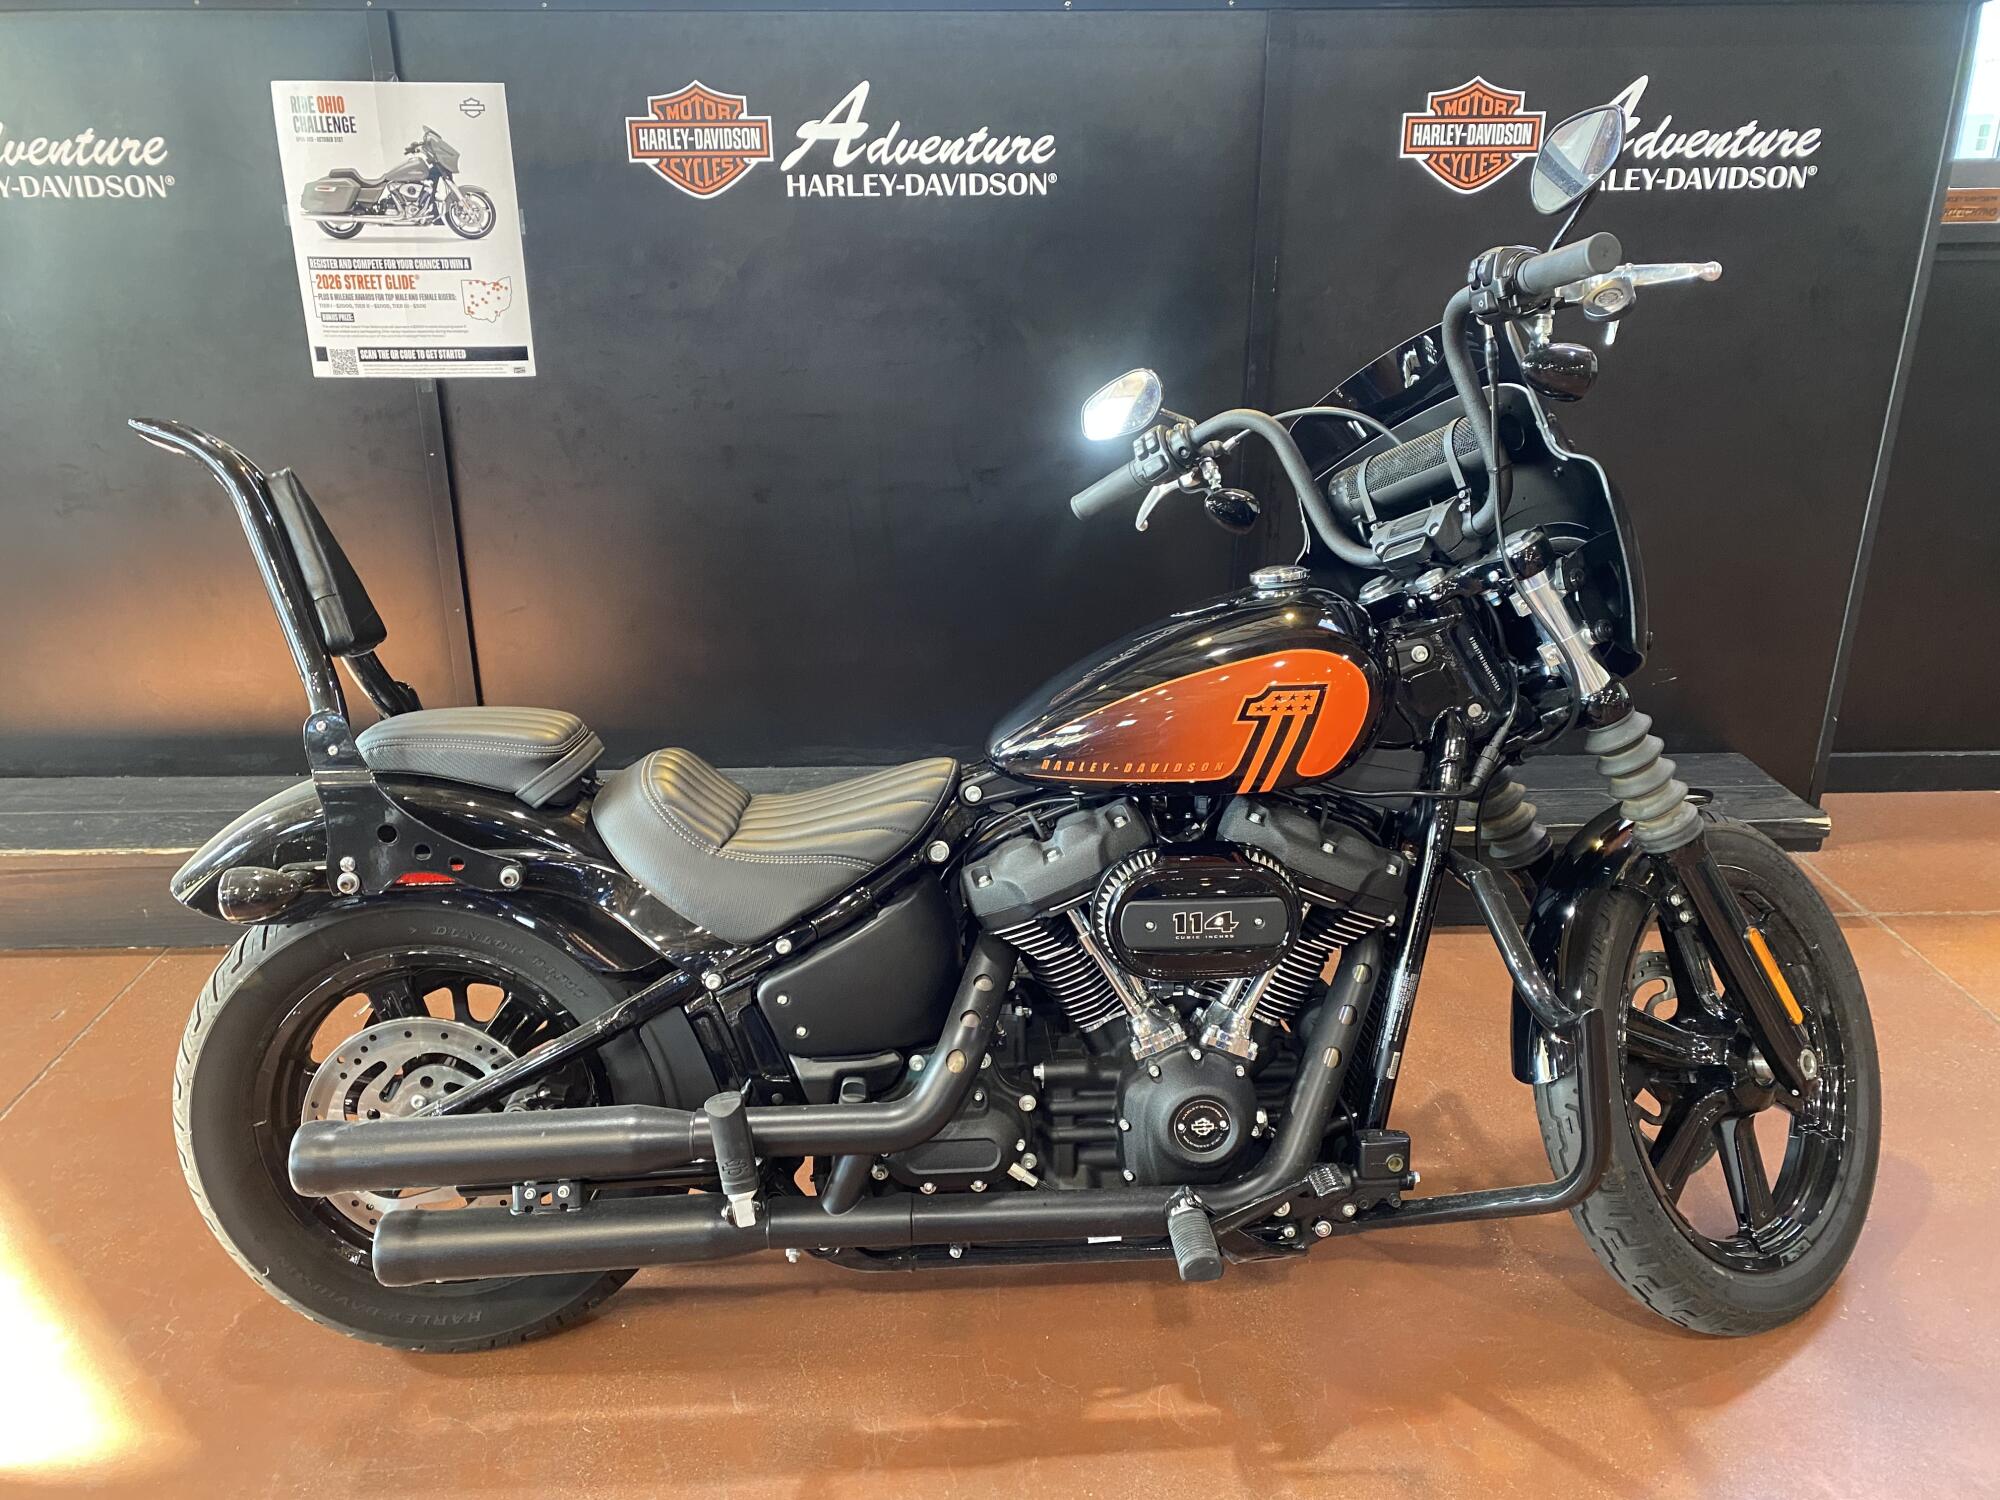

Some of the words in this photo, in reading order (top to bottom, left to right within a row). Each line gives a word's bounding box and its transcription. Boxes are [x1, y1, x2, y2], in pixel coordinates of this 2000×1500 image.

[290, 96, 315, 113] RIDE
[317, 96, 345, 113] OHIO
[665, 99, 731, 121] MOTOR
[1443, 94, 1508, 118] MOTOR
[293, 115, 357, 133] CHALLENGE
[780, 80, 1057, 171] Adventure
[1411, 121, 1534, 148] HARLEY-DAVIDSON
[0, 121, 168, 166] venture
[638, 126, 762, 152] HARLEY-DAVIDSON
[669, 157, 735, 187] CYCLES
[1439, 152, 1503, 184] CYCLES
[310, 259, 338, 269] REGISTER
[339, 259, 352, 269] AND
[353, 259, 383, 269] COMPETE
[384, 259, 396, 269] FOR
[397, 259, 414, 269] YOUR
[415, 259, 440, 269] CHANCE
[441, 259, 449, 269] TO
[449, 259, 463, 269] WIN
[464, 259, 469, 269] A
[316, 274, 342, 290] 2026
[344, 274, 382, 290] STREET
[385, 293, 394, 301] TOP
[420, 293, 437, 301] FEMALE
[360, 349, 377, 360] SCAN
[377, 349, 390, 360] THE
[400, 349, 416, 360] CODE
[417, 349, 425, 360] TO
[426, 349, 438, 360] GET
[439, 349, 466, 360] STARTED
[1040, 759, 1225, 773] HARLEY-DAVIDSON
[1172, 911, 1240, 934] 114
